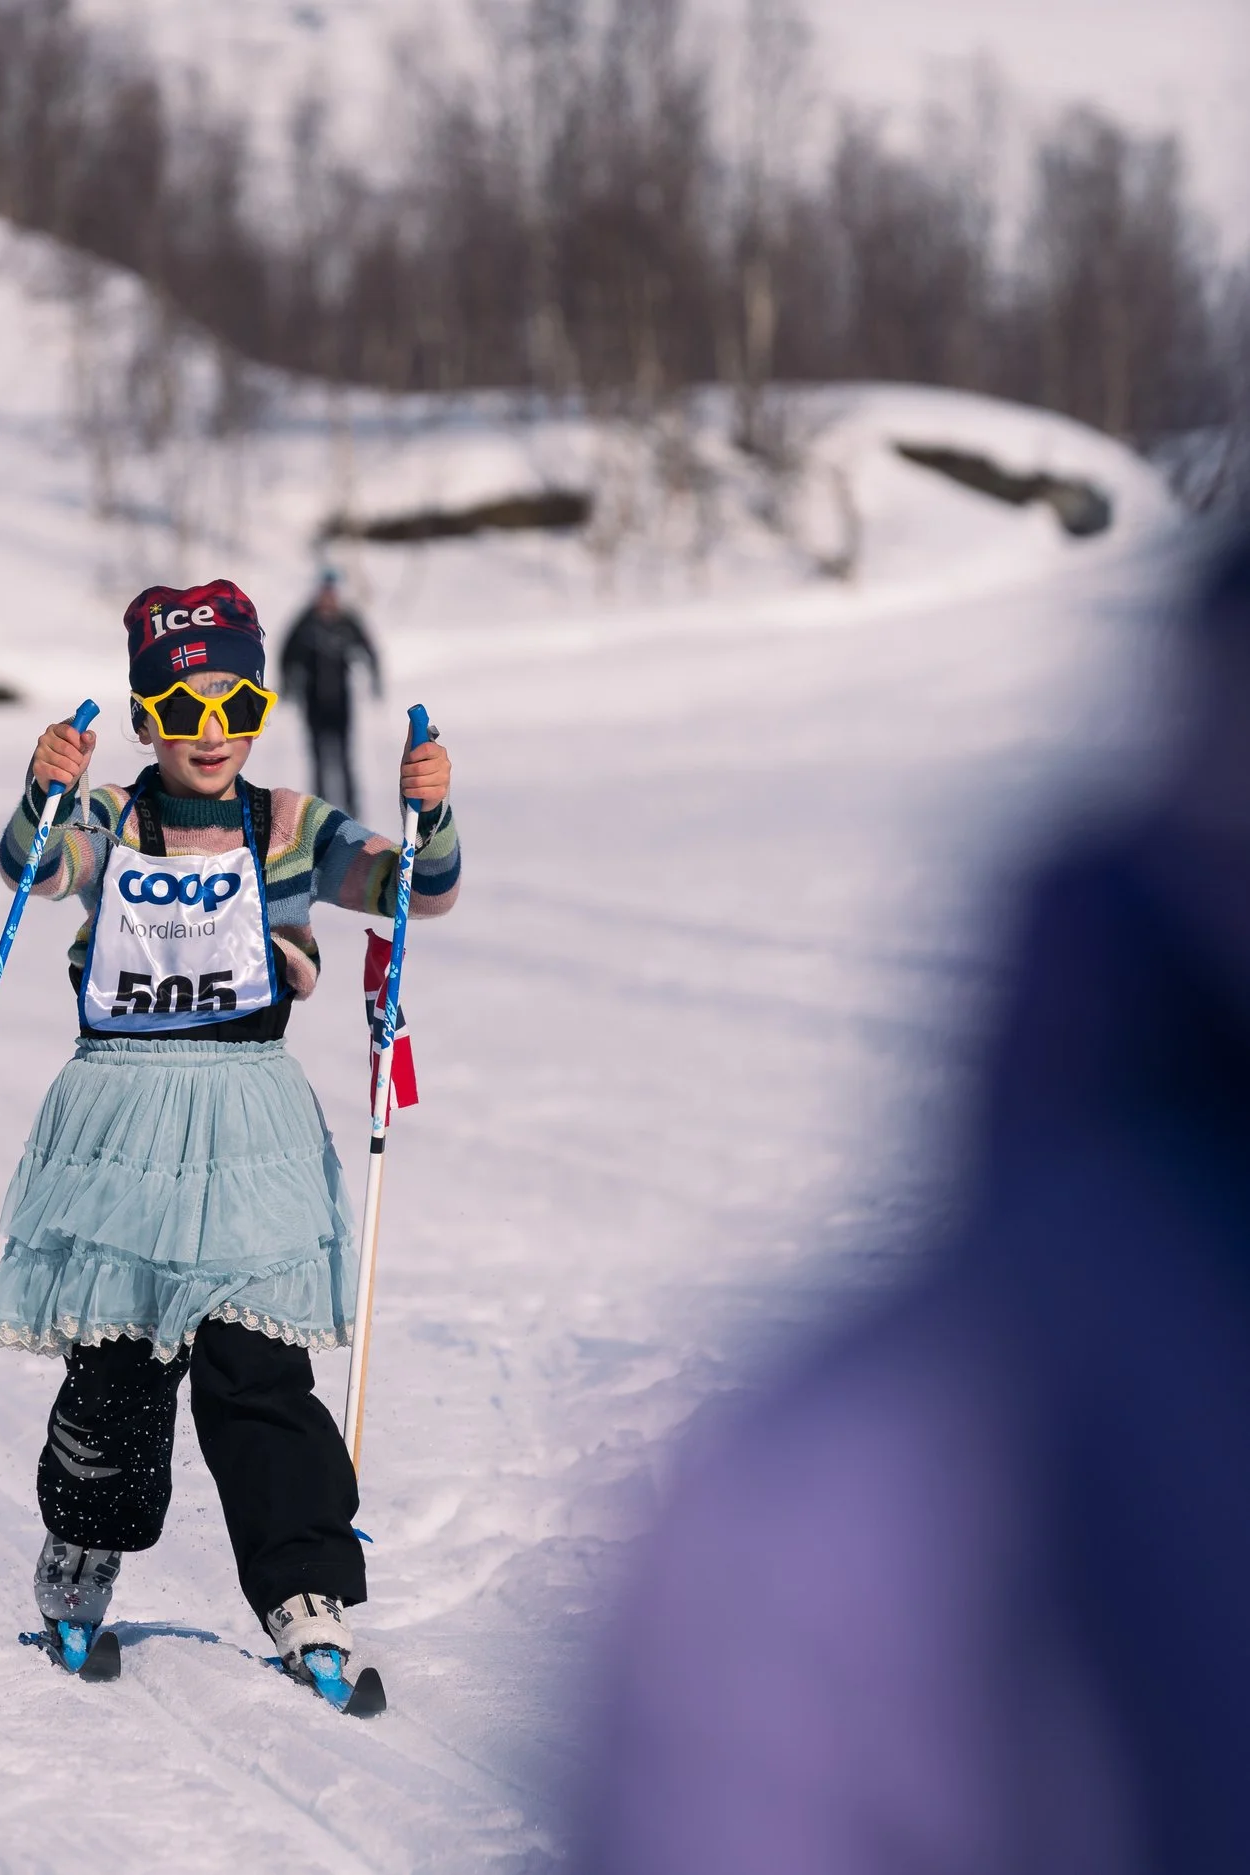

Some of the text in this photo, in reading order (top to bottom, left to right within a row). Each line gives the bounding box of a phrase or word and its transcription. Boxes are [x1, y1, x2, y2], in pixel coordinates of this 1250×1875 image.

[150, 604, 216, 639] ice
[119, 869, 241, 912] coop
[119, 914, 215, 940] Nordland
[111, 970, 237, 1018] 505
